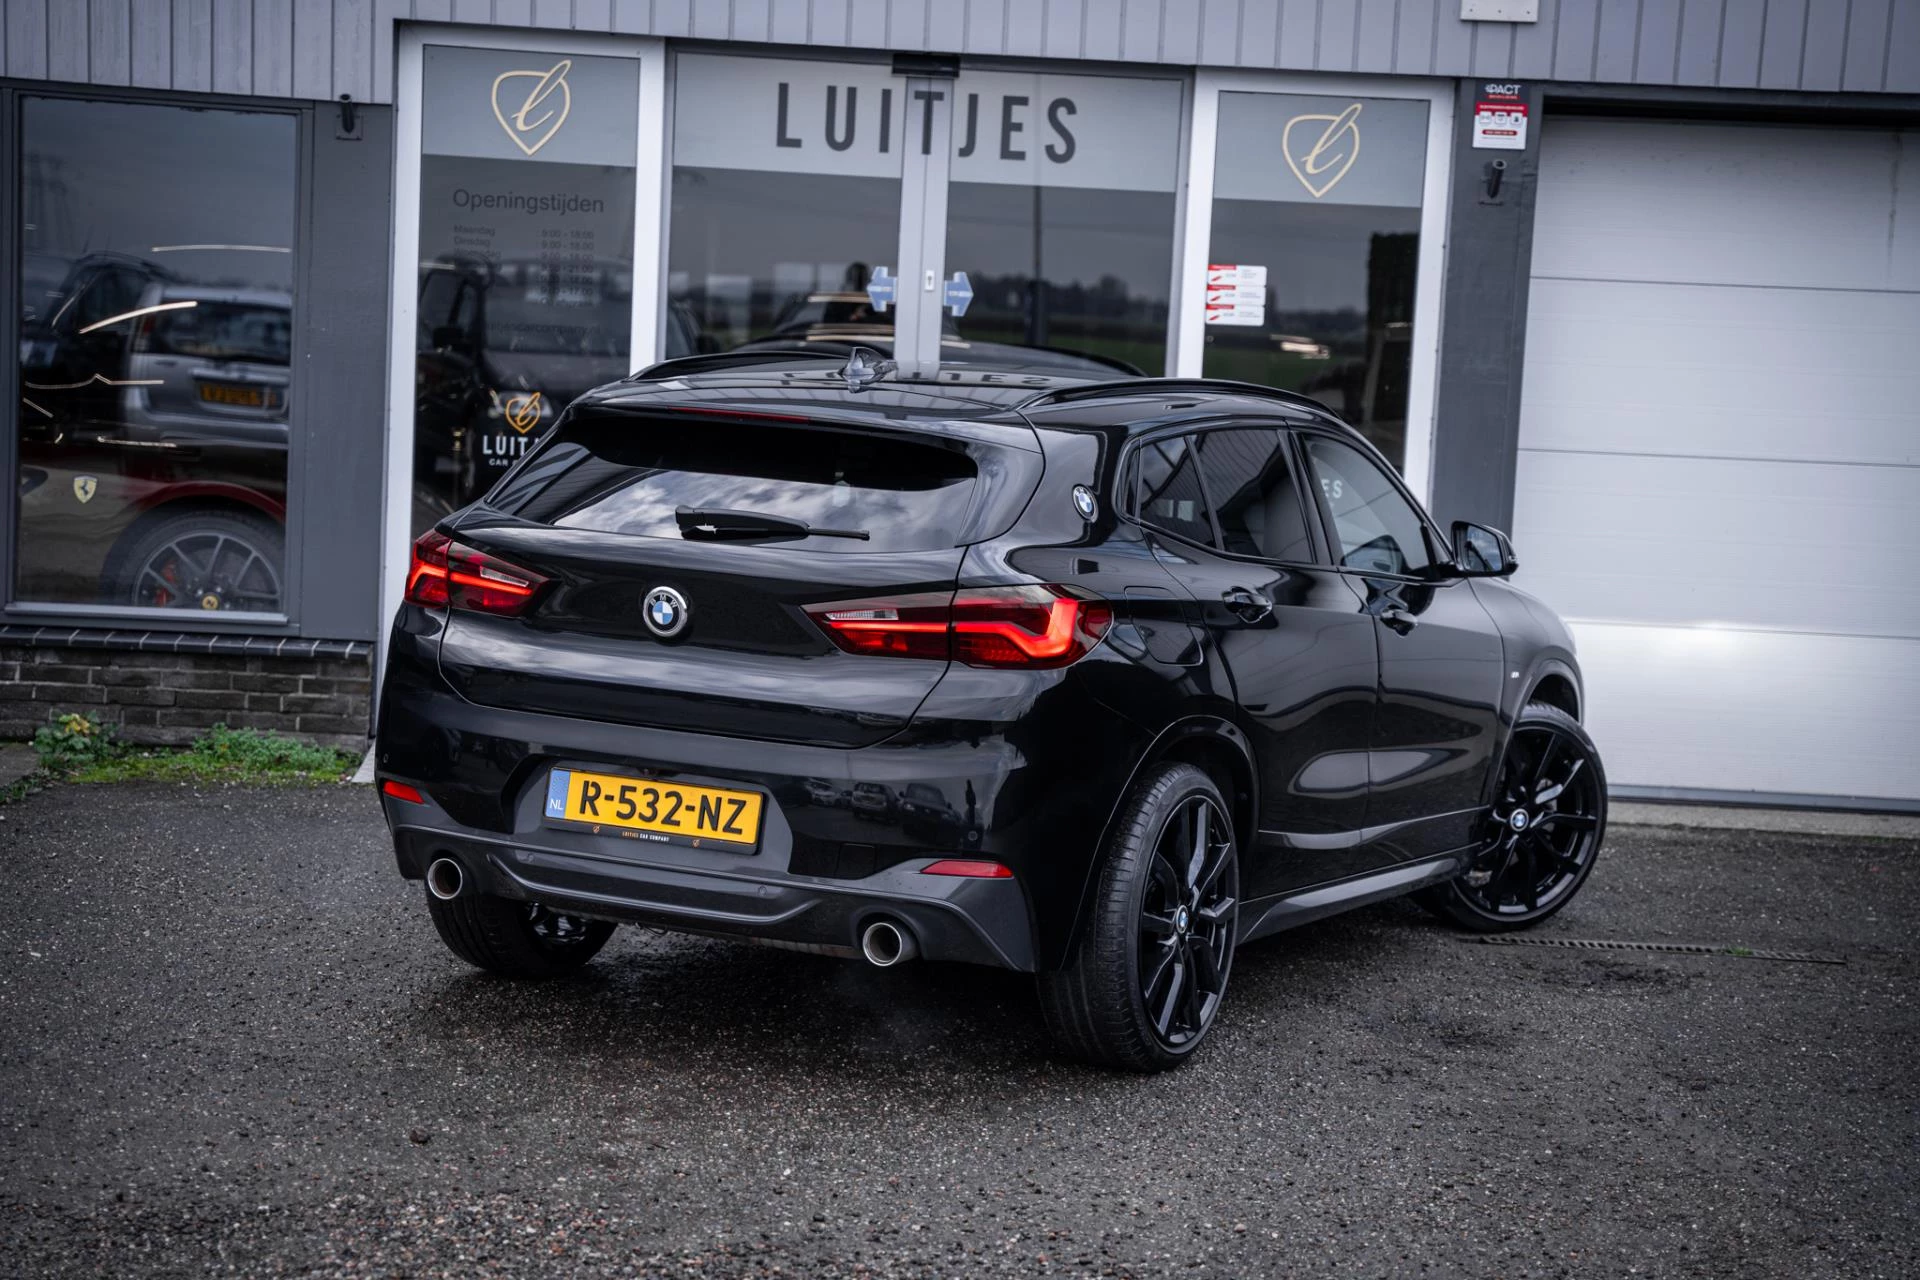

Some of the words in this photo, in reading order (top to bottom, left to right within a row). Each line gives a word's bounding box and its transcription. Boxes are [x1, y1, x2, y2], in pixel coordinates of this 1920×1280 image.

[776, 82, 1077, 164] LUITJES
[453, 188, 604, 216] Openingstijden
[482, 435, 541, 457] LUIT
[550, 799, 563, 811] NL
[579, 780, 748, 835] R-532-NZ
